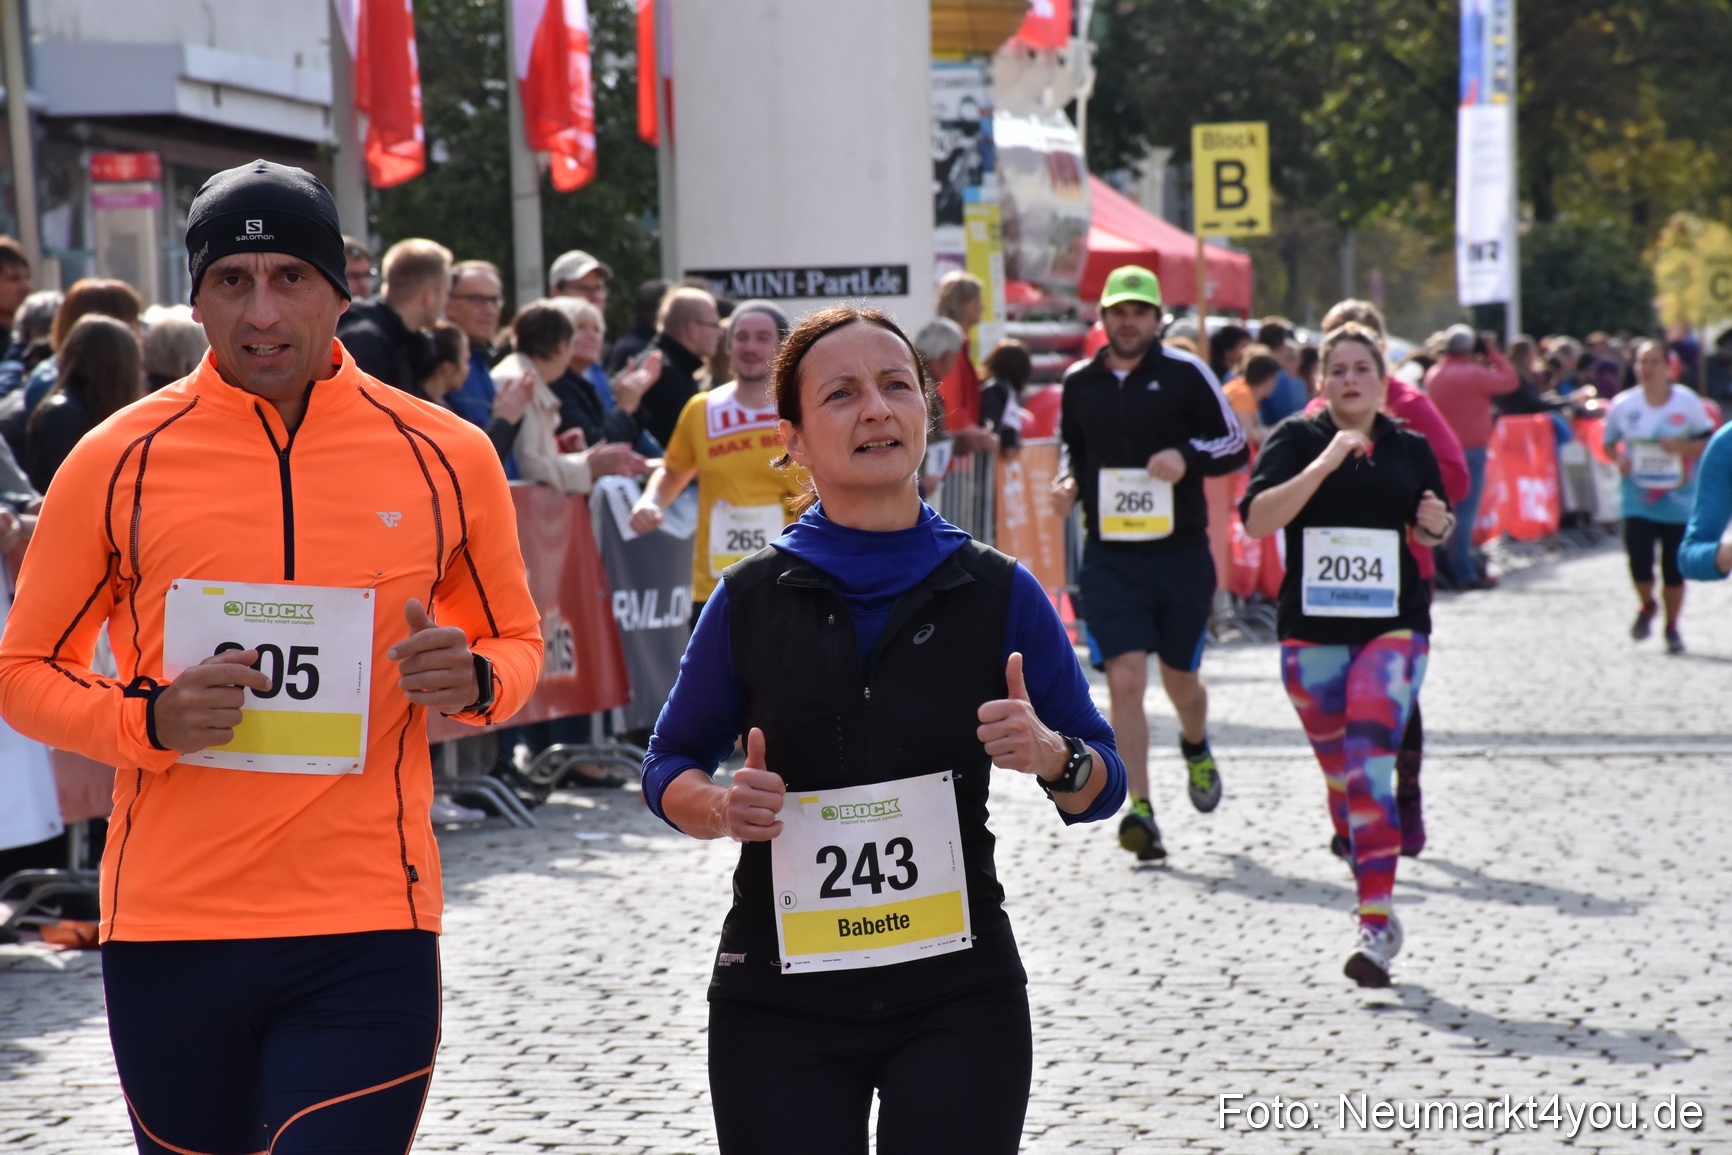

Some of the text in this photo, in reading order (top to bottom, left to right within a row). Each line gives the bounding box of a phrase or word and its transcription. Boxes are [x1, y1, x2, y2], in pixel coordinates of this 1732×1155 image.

[1214, 160, 1248, 210] B
[708, 438, 752, 458] MAX
[1115, 491, 1153, 513] 266
[727, 529, 766, 551] 265
[1318, 556, 1383, 582] 2034
[245, 602, 314, 619] BOCK
[213, 642, 320, 700] 05
[839, 798, 901, 819] BOCK
[815, 837, 918, 899] 243
[784, 895, 792, 905] D
[837, 912, 910, 937] Babette
